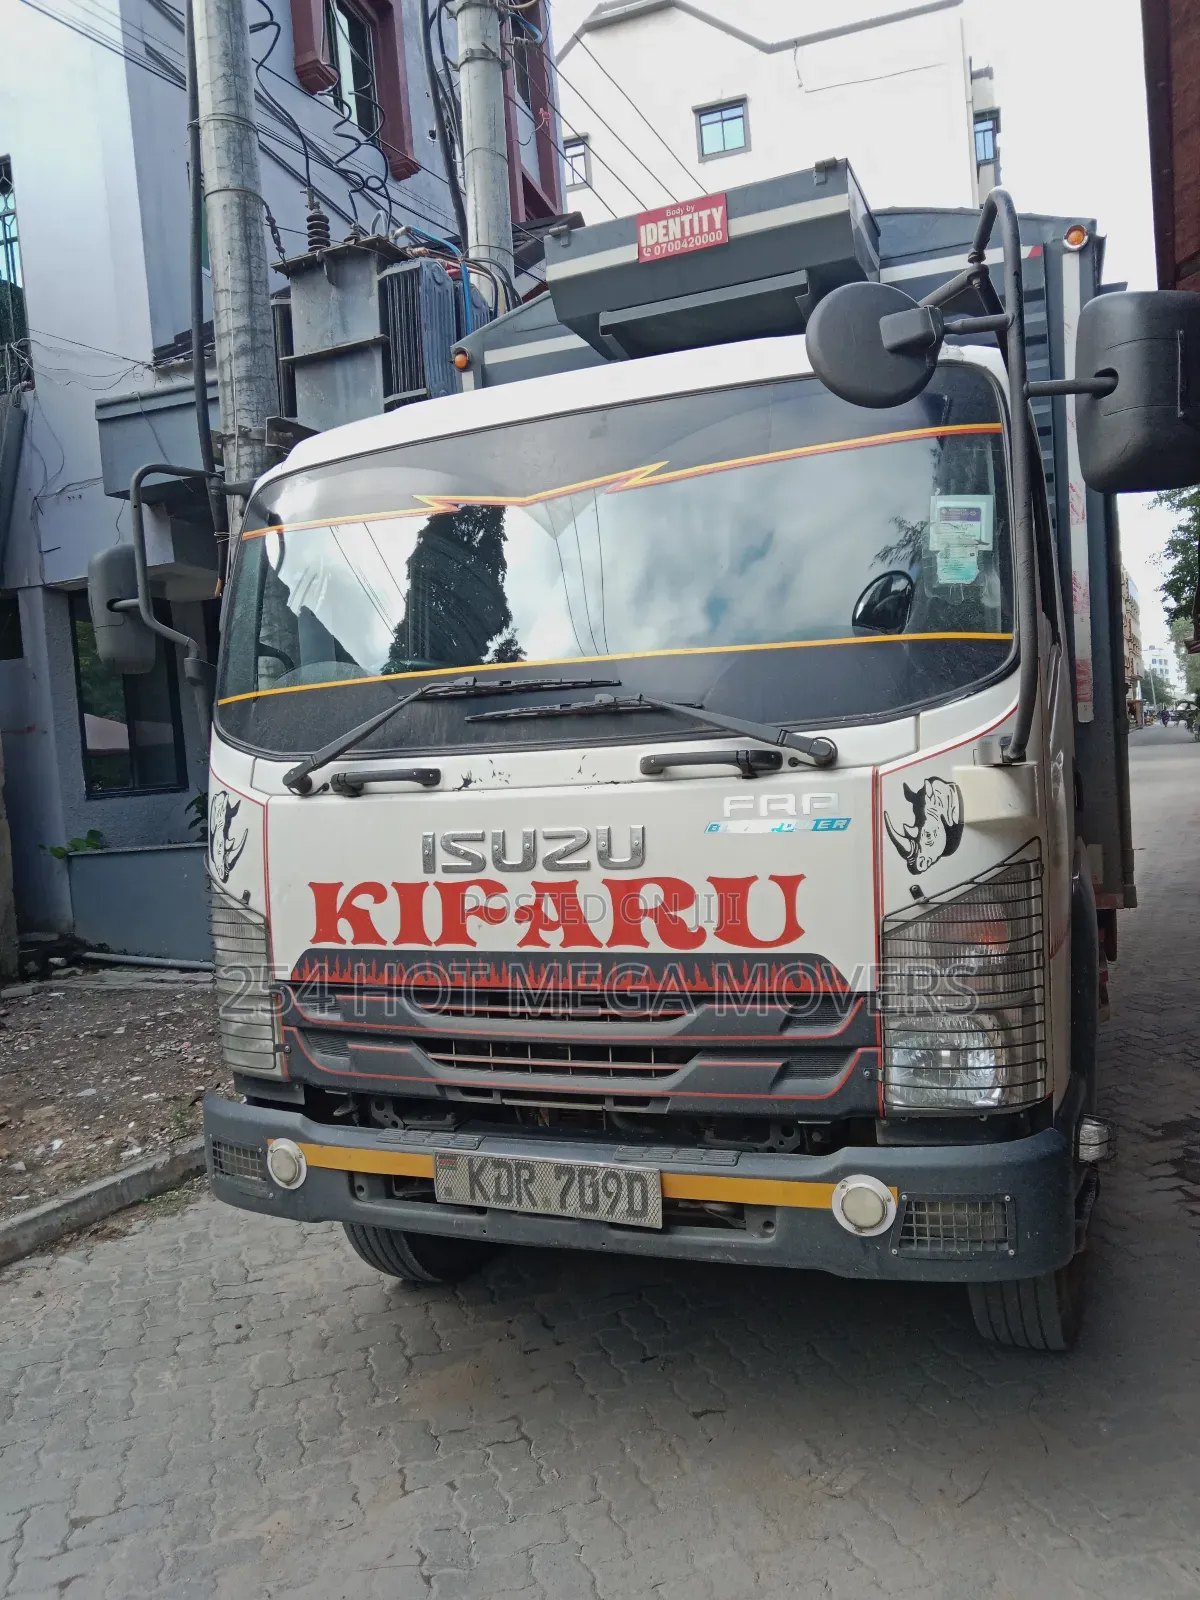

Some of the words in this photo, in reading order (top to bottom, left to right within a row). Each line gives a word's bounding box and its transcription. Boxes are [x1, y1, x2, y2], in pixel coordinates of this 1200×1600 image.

[640, 206, 723, 247] IDENTITY
[666, 205, 684, 217] Body
[686, 204, 695, 212] by
[654, 230, 723, 256] 0700420000
[422, 825, 646, 874] ISUZU
[307, 874, 807, 950] KIFARU
[467, 1157, 538, 1208] KDR
